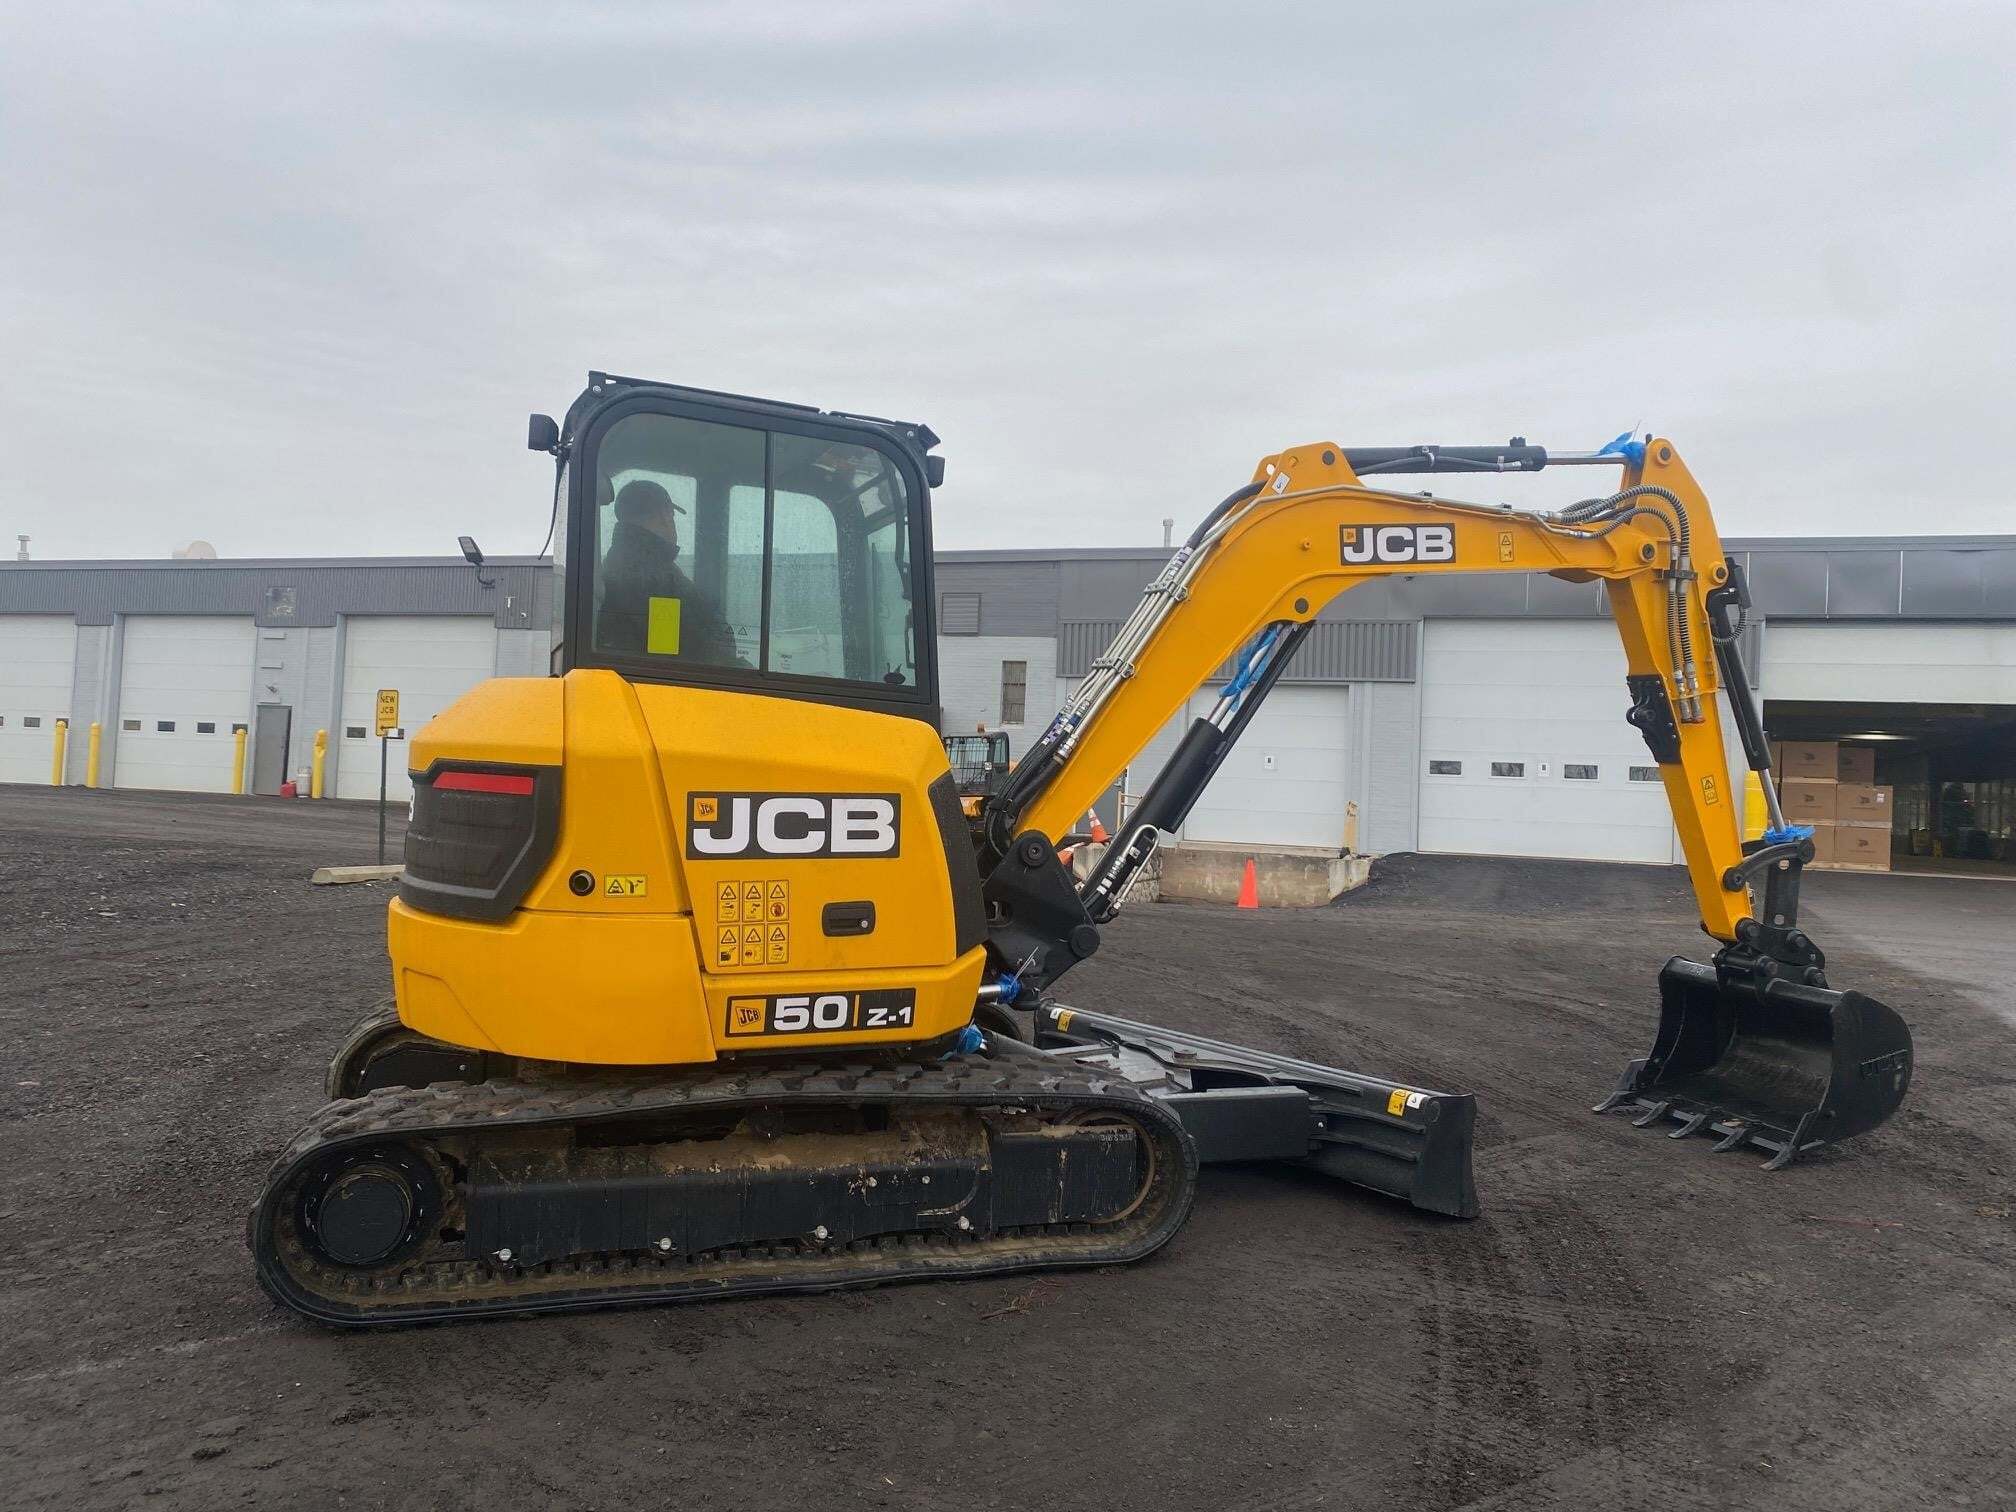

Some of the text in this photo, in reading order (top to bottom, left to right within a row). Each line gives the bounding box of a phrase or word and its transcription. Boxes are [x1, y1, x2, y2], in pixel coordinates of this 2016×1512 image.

[1343, 526, 1454, 563] JCB
[380, 695, 395, 704] NEW
[380, 706, 395, 714] JCB
[693, 797, 896, 854] JCB
[738, 995, 912, 1031] JCB 50 Z-1
